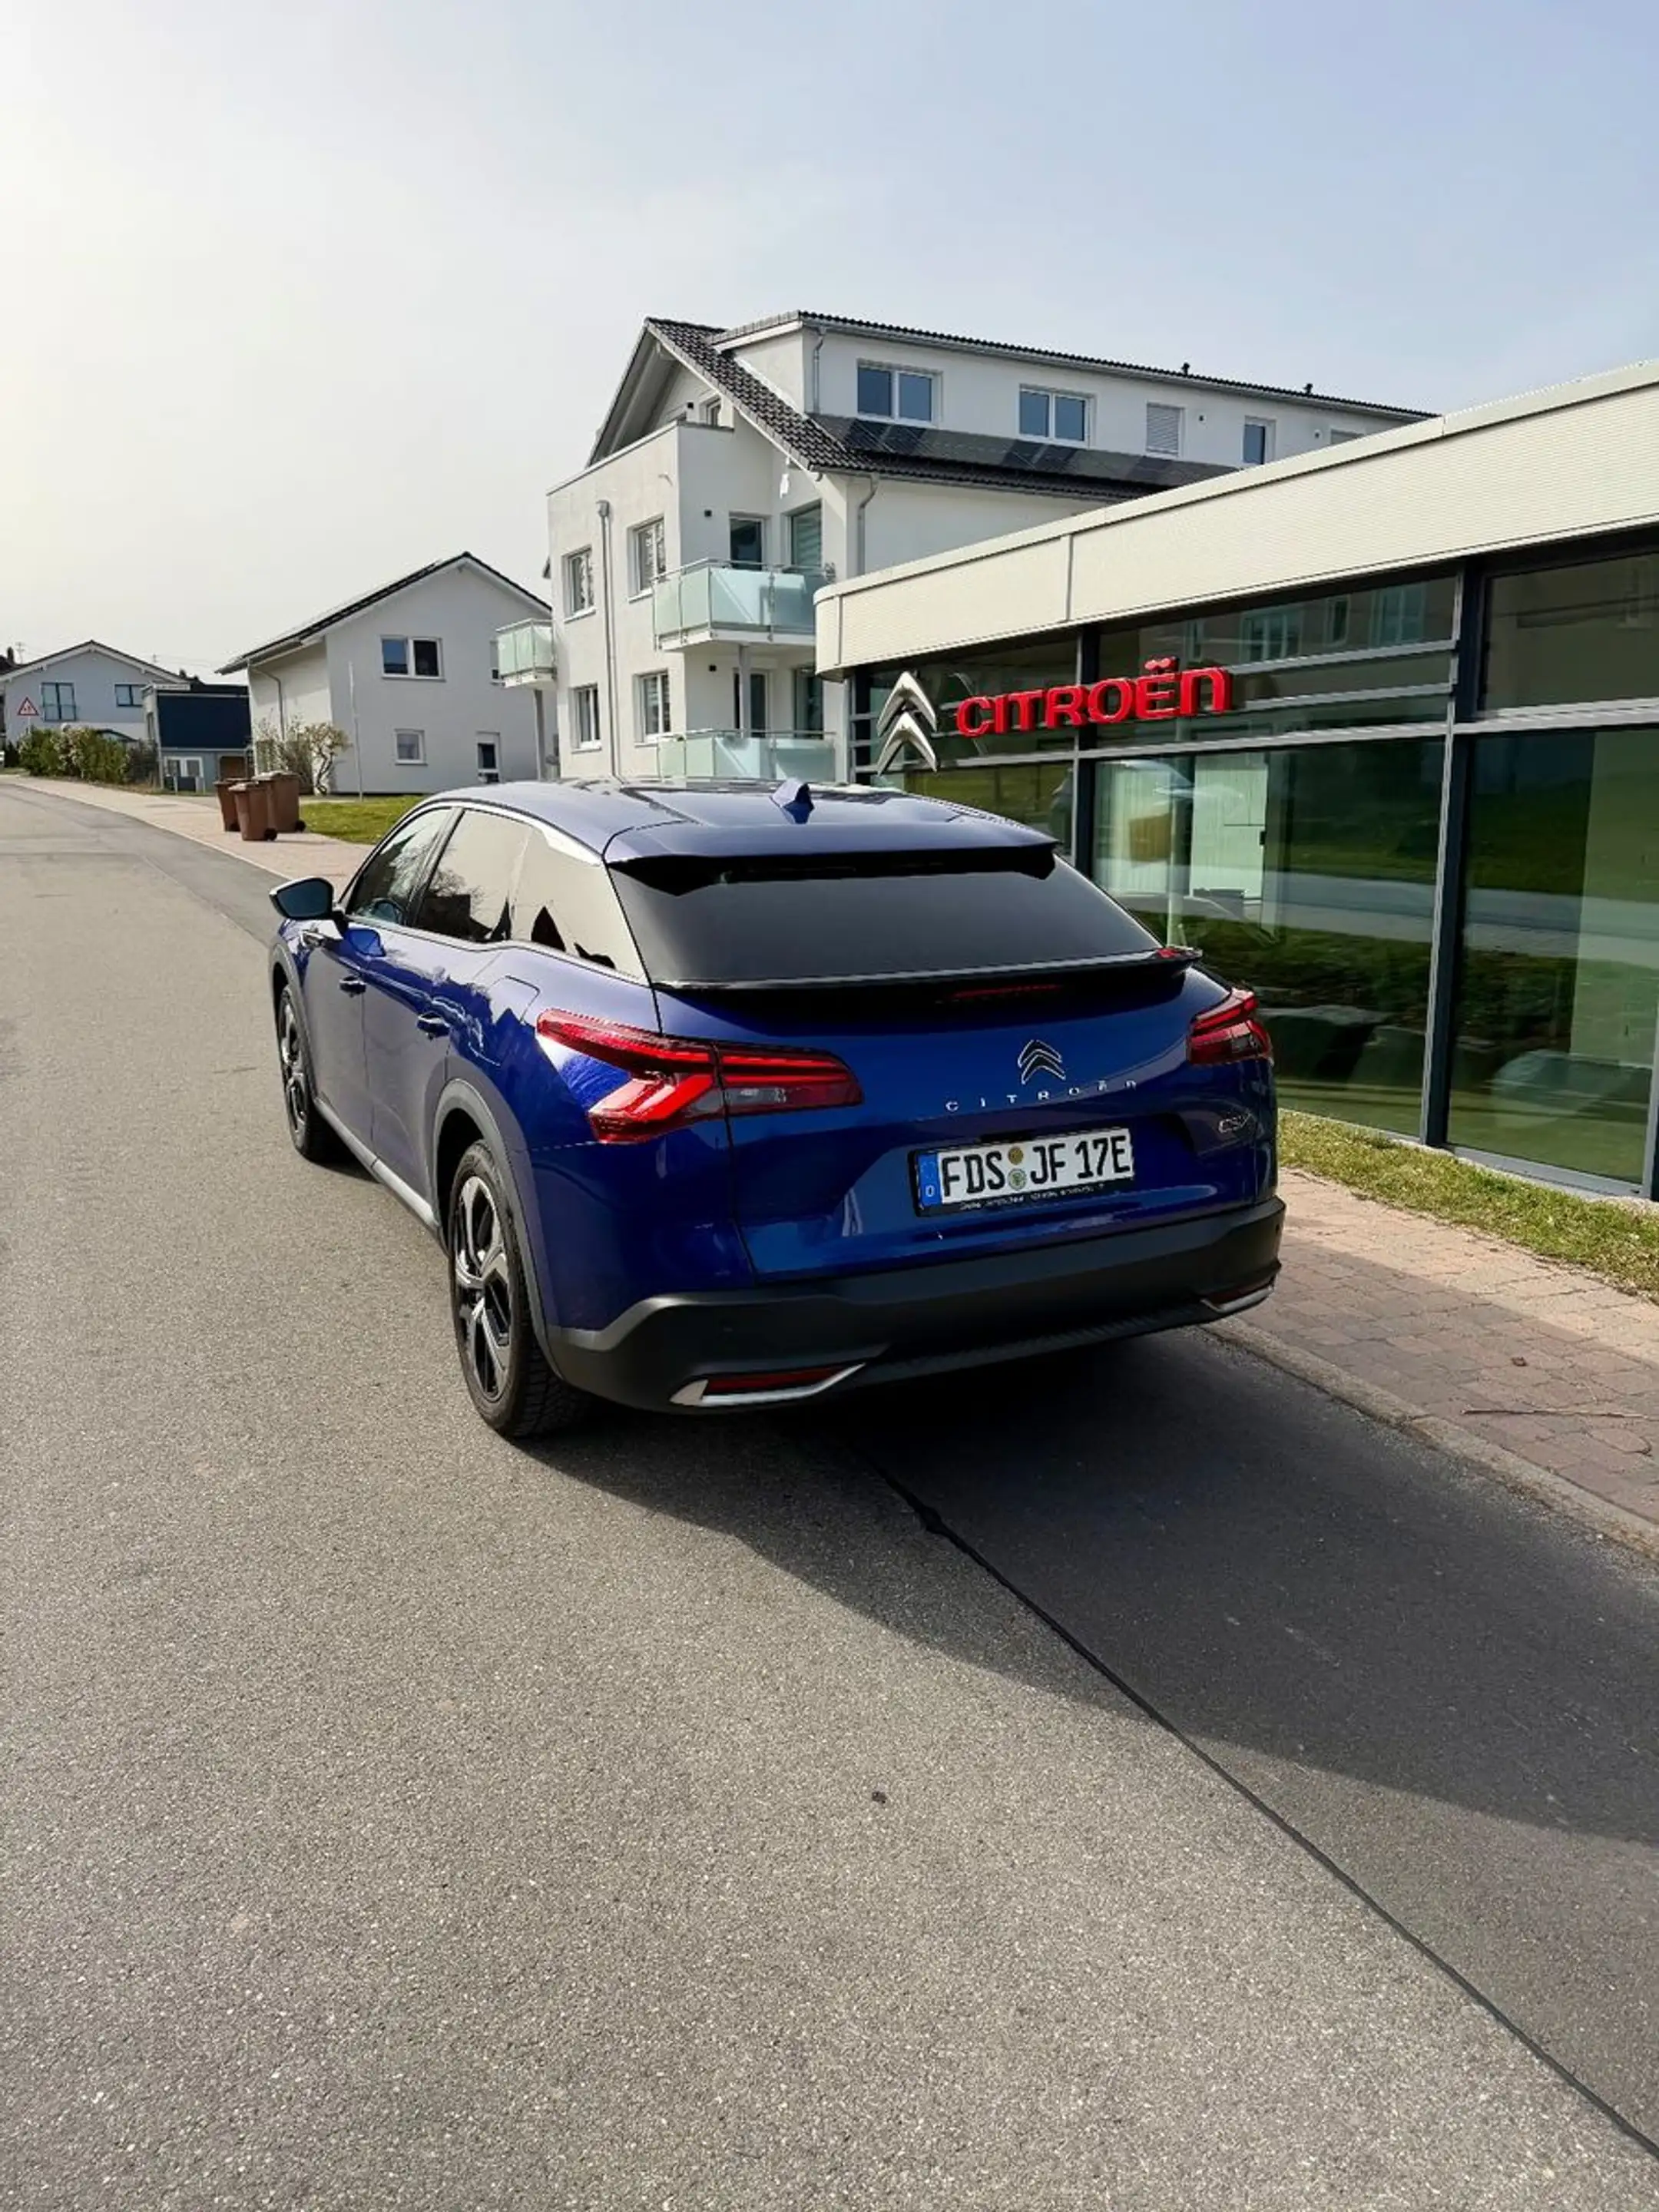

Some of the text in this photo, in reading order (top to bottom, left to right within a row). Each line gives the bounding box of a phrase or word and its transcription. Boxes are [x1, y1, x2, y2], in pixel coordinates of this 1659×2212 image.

[955, 656, 1232, 738] CITROËN
[942, 1135, 1131, 1197] FDS JF 17E
